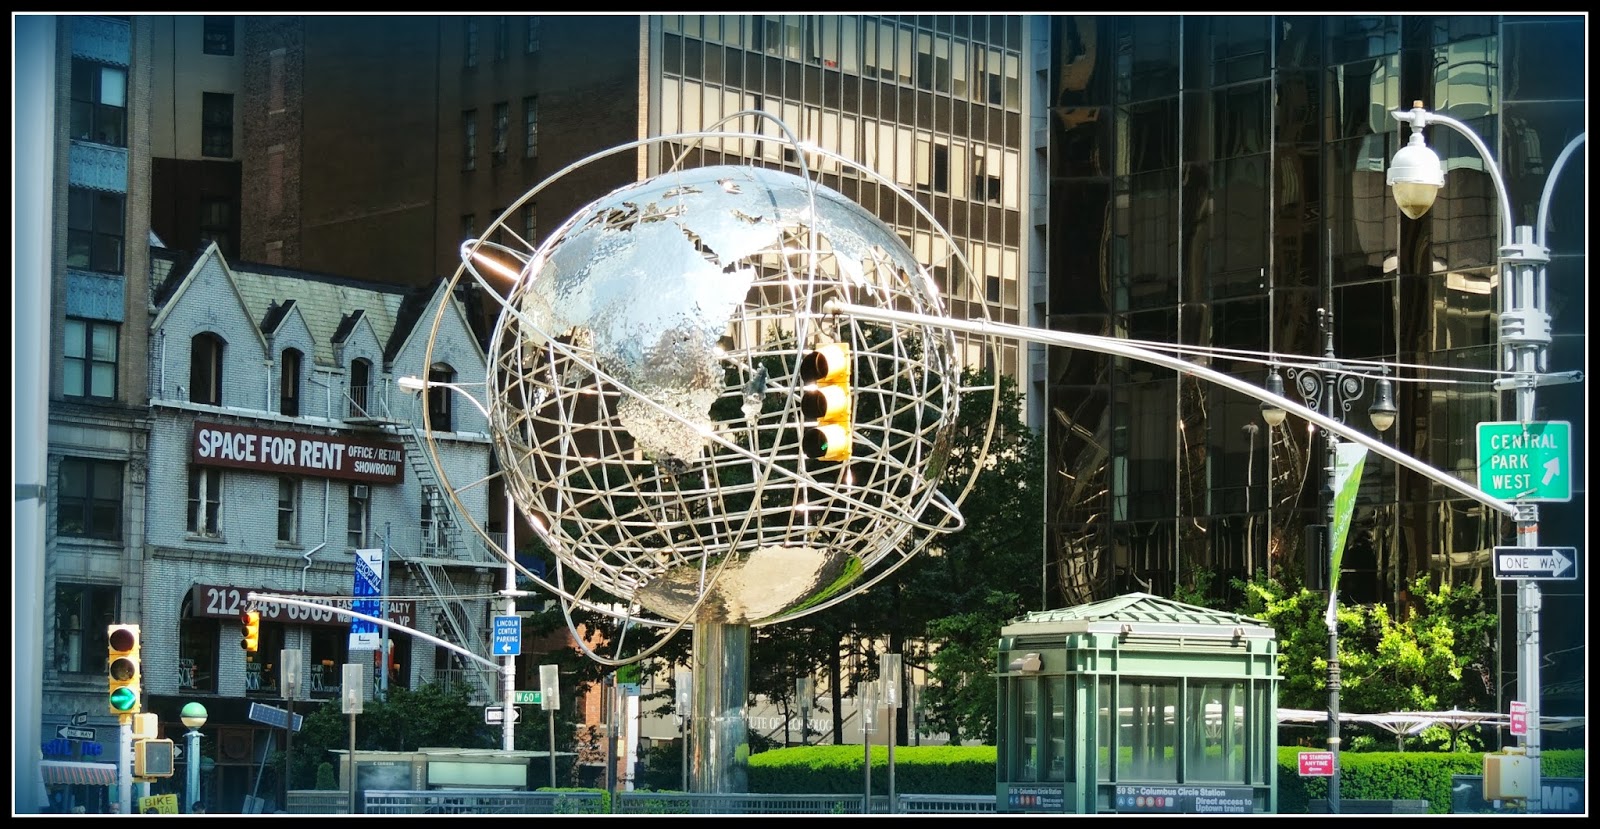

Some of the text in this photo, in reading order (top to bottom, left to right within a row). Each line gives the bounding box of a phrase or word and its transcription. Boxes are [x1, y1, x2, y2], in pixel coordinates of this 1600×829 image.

[1491, 434, 1558, 449] CENTRAL
[199, 428, 345, 471] SPACE FOR RENT
[1491, 454, 1529, 469] PARK
[354, 461, 397, 477] SHOWROOM
[1492, 474, 1531, 489] WEST
[1506, 558, 1564, 569] ONE WAY
[356, 557, 374, 578] SHOP
[371, 575, 381, 587] IN
[516, 693, 523, 702] W
[523, 693, 534, 702] 60
[1116, 787, 1126, 795] 59
[1127, 787, 1136, 795] St
[1140, 787, 1177, 796] Columbus
[1177, 788, 1200, 796] Circle
[1200, 788, 1226, 797] Station
[144, 796, 173, 807] BIKE
[1195, 797, 1218, 805] Direct
[1195, 805, 1223, 813] Uptown
